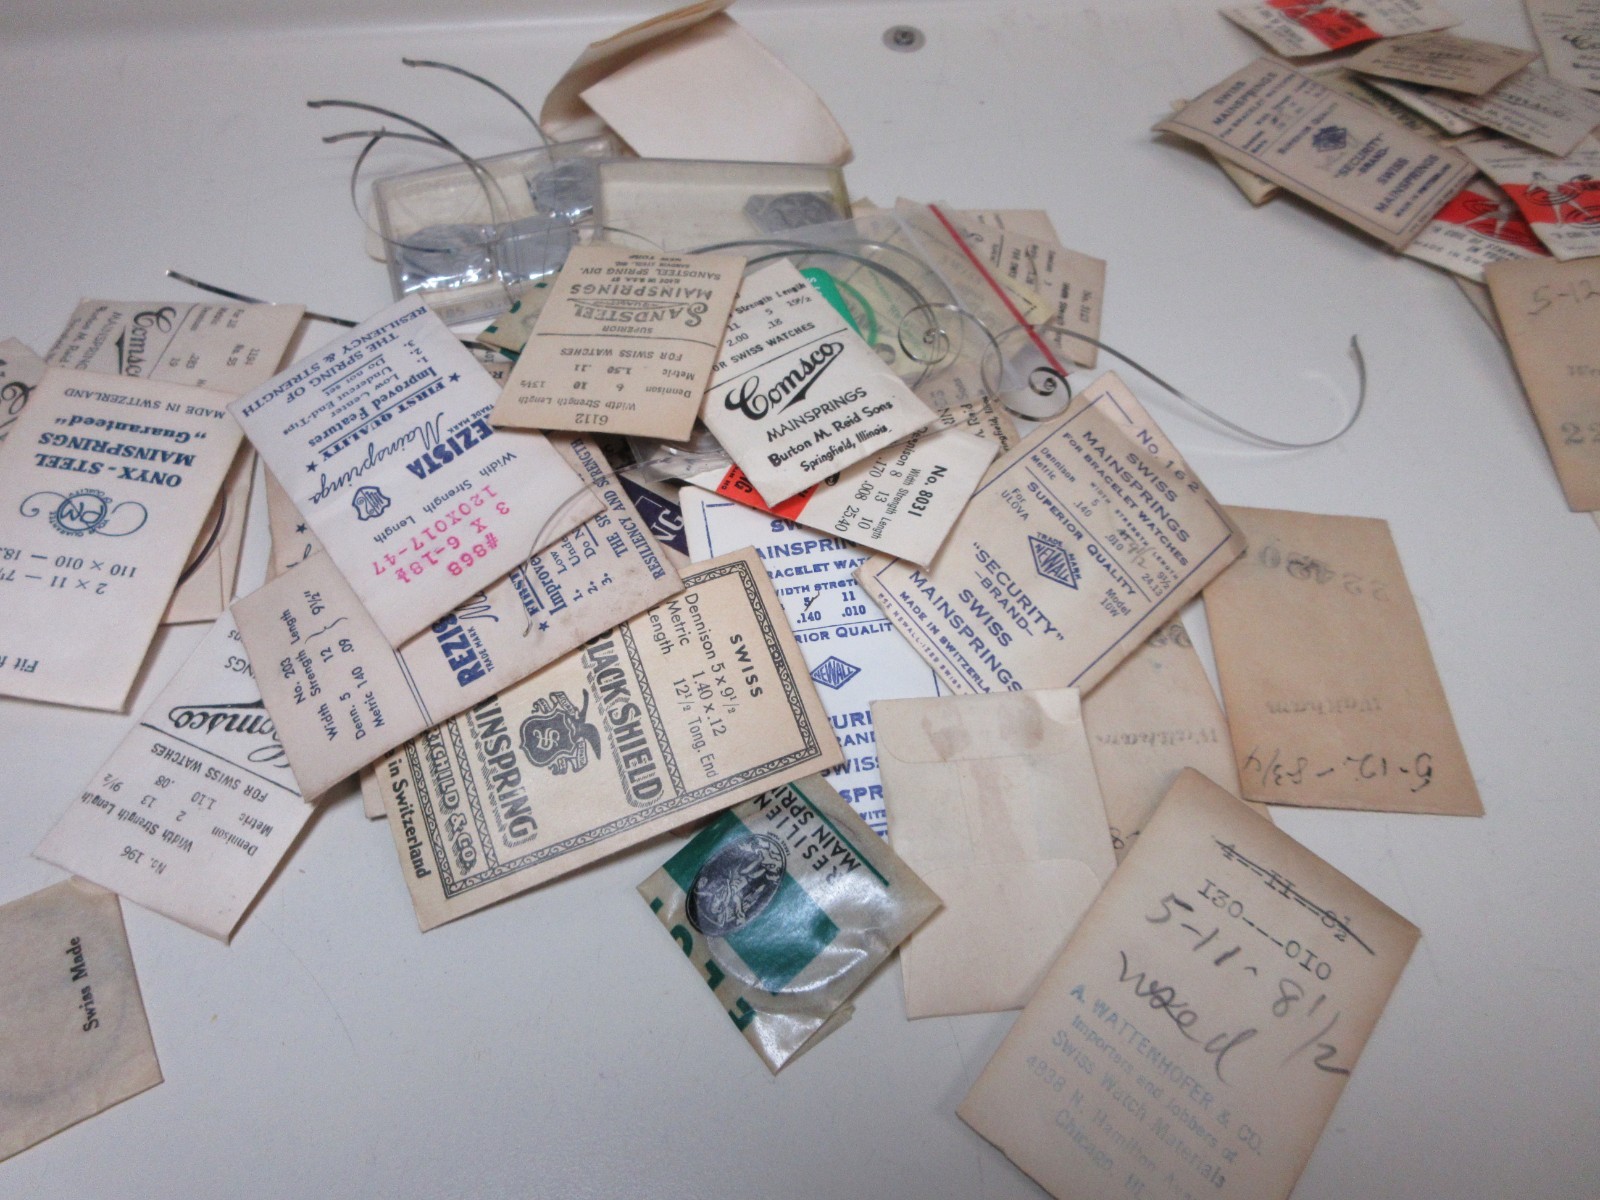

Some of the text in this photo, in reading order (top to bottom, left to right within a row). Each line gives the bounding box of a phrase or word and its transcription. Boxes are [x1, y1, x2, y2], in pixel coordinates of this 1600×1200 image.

[1375, 154, 1440, 212] MAINSPRINGS
[569, 280, 713, 305] MAINSPRINGS
[606, 267, 721, 280] SANDSTEEL SPRING
[342, 306, 428, 354] RESILIENCY
[560, 348, 683, 362] FOR SWISS WATCHES
[602, 325, 653, 334] SUPERIOR
[726, 332, 749, 347] 2.00
[730, 322, 815, 363] SWISS WATCHES
[242, 362, 320, 417] STRENGTH
[287, 333, 399, 404] THE SPRING OF
[322, 382, 341, 396] set
[337, 366, 393, 401] Undercut
[374, 373, 400, 390] Low
[607, 366, 695, 381] Metric 1.50
[645, 386, 692, 399] Dennison
[724, 342, 845, 422] Comsco
[64, 388, 226, 419] MADE IN SWITZERLAND
[308, 366, 437, 447] Improved Features
[318, 382, 445, 461] FIRST QUALITY
[447, 418, 470, 433] MARK
[518, 395, 636, 411] Width Strength Length
[574, 413, 609, 426] 6112
[766, 387, 867, 442] MAINSPRINGS
[38, 432, 195, 466] MAINSPRINGS
[308, 412, 457, 504] Mainsprings
[767, 401, 893, 467] Burton Reid Sons
[800, 438, 856, 472] Springfield,
[1040, 447, 1076, 482] Dennison
[1082, 430, 1190, 542] MAINSPRINGS
[1126, 452, 1178, 502] SWISS
[373, 452, 517, 543] Width Strength Length
[496, 502, 510, 515] 3
[604, 490, 625, 511] AND
[834, 454, 888, 532] .170 .008 25.40
[857, 491, 890, 530] 13 10
[870, 468, 921, 540] Width Strength Length
[908, 465, 948, 517] No. 8031
[1083, 454, 1138, 508] BRACELET
[1138, 510, 1188, 566] WATCHES
[582, 540, 596, 559] Do
[606, 532, 628, 558] THE
[618, 516, 666, 580] RESILIENCY
[1027, 476, 1136, 595] SUPERIOR QUALITY
[1030, 454, 1163, 597] Metric 24.13
[55, 556, 136, 577] 110 010
[447, 532, 498, 576] #868
[550, 551, 568, 575] Low
[1011, 488, 1132, 616] For Model
[95, 582, 108, 594] 2
[899, 591, 928, 621] MADE
[926, 622, 940, 635] IN
[684, 592, 716, 660] Dennison
[711, 662, 726, 673] 5
[796, 604, 866, 624] .140 .010
[958, 589, 1013, 647] SWISS
[467, 626, 495, 672] TRADE MARK
[659, 596, 714, 700] Metric 1.40
[730, 634, 763, 698] SWISS
[810, 660, 856, 684] NEWALL
[280, 609, 338, 741] Width Strength Length
[280, 657, 306, 705] No. 203
[320, 646, 366, 740] Denn. 5 12
[338, 638, 385, 728] Metric 140 .09
[151, 743, 268, 802] FOR SWISS WATCHES
[592, 700, 680, 808] SHIELD
[688, 716, 719, 778] Tong. End
[81, 792, 193, 853] Width Strength Length
[140, 794, 258, 856] Dennison 2 13
[190, 791, 273, 837] Metric 1.10
[388, 758, 450, 879] in Switzerland
[750, 790, 837, 878] RESILIEN
[120, 846, 167, 875] No. 196
[811, 824, 862, 872] MAIN
[70, 937, 97, 1032] Swiss Made
[1072, 1015, 1136, 1080] Importers
[1093, 1000, 1267, 1158] WATTENHOFER CO.
[1052, 1030, 1232, 1192] Swiss Watch Materials
